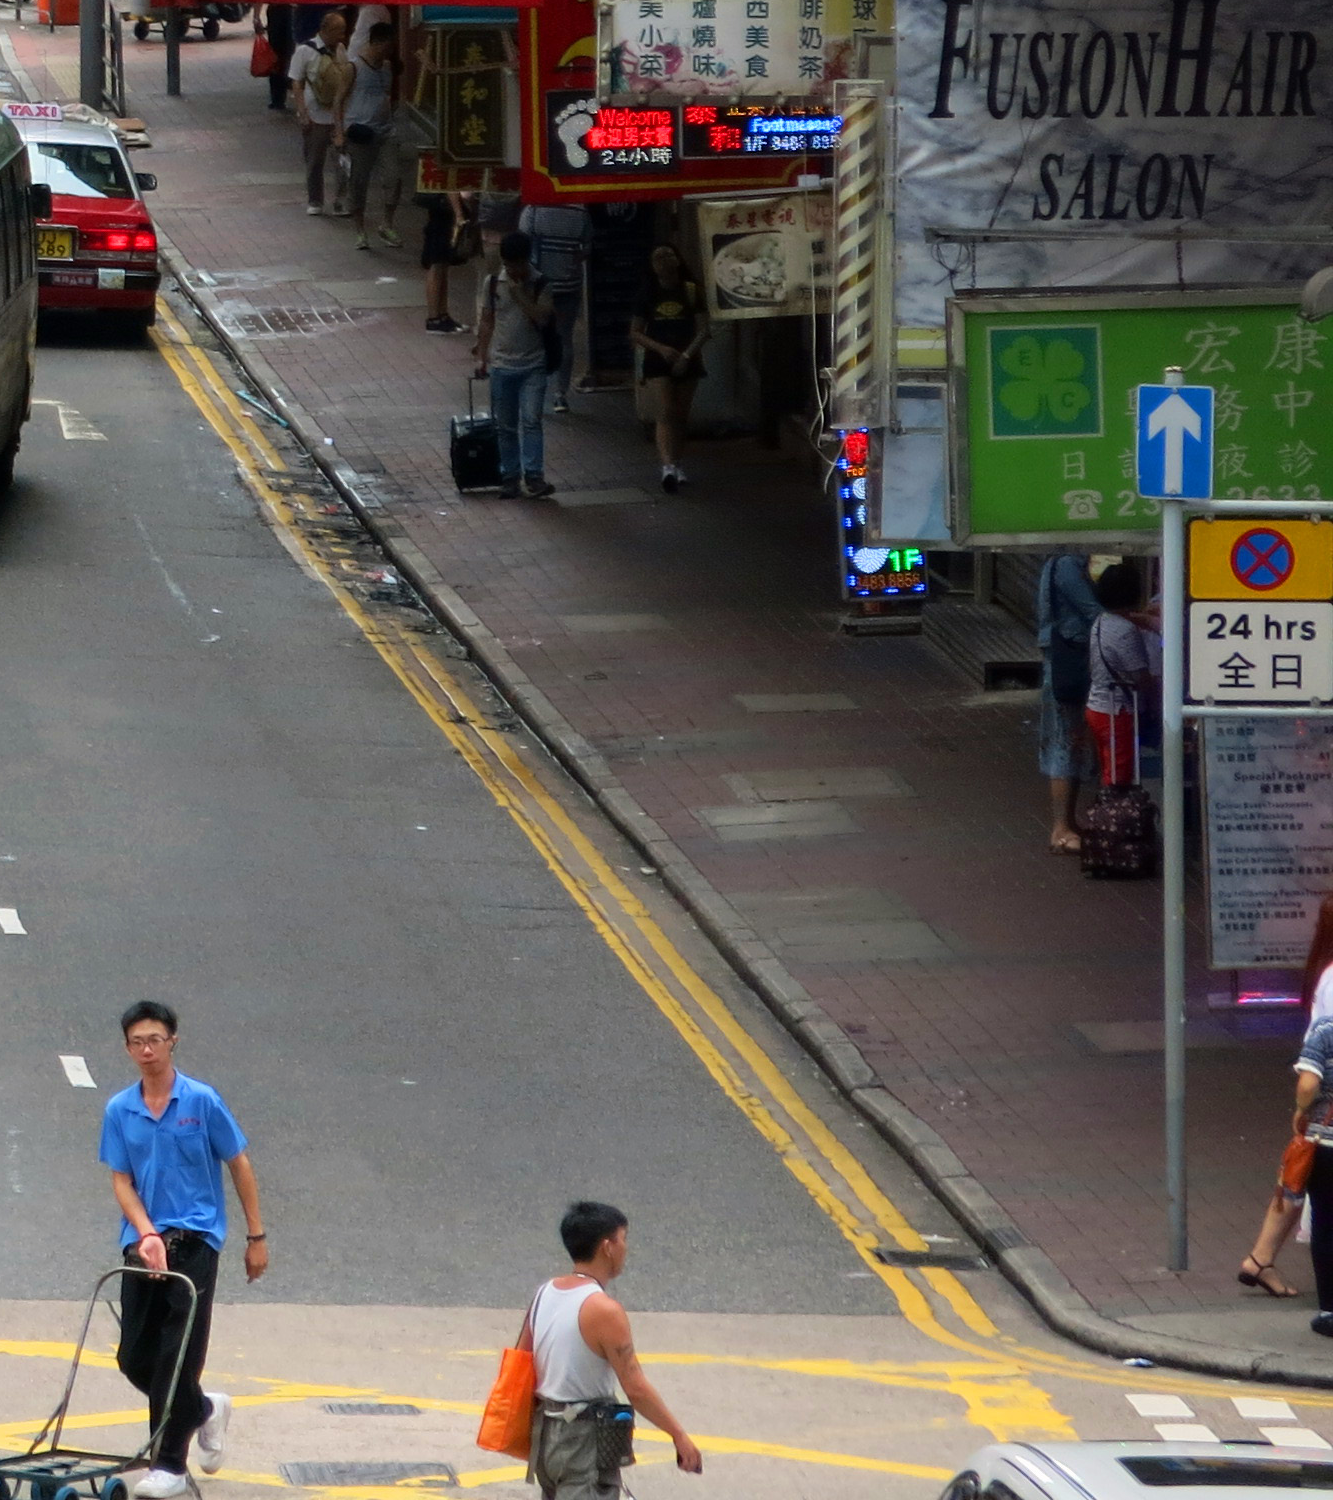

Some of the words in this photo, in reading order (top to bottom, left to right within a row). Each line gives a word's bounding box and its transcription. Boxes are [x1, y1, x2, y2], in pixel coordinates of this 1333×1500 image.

[7, 104, 57, 118] TAXI
[595, 109, 671, 127] Welcome
[600, 149, 673, 167] 24小時
[1032, 152, 1213, 221] SALON
[1206, 612, 1251, 641] 24
[1264, 612, 1316, 641] hrs
[1217, 651, 1304, 690] 全日
[1234, 771, 1276, 785] Special
